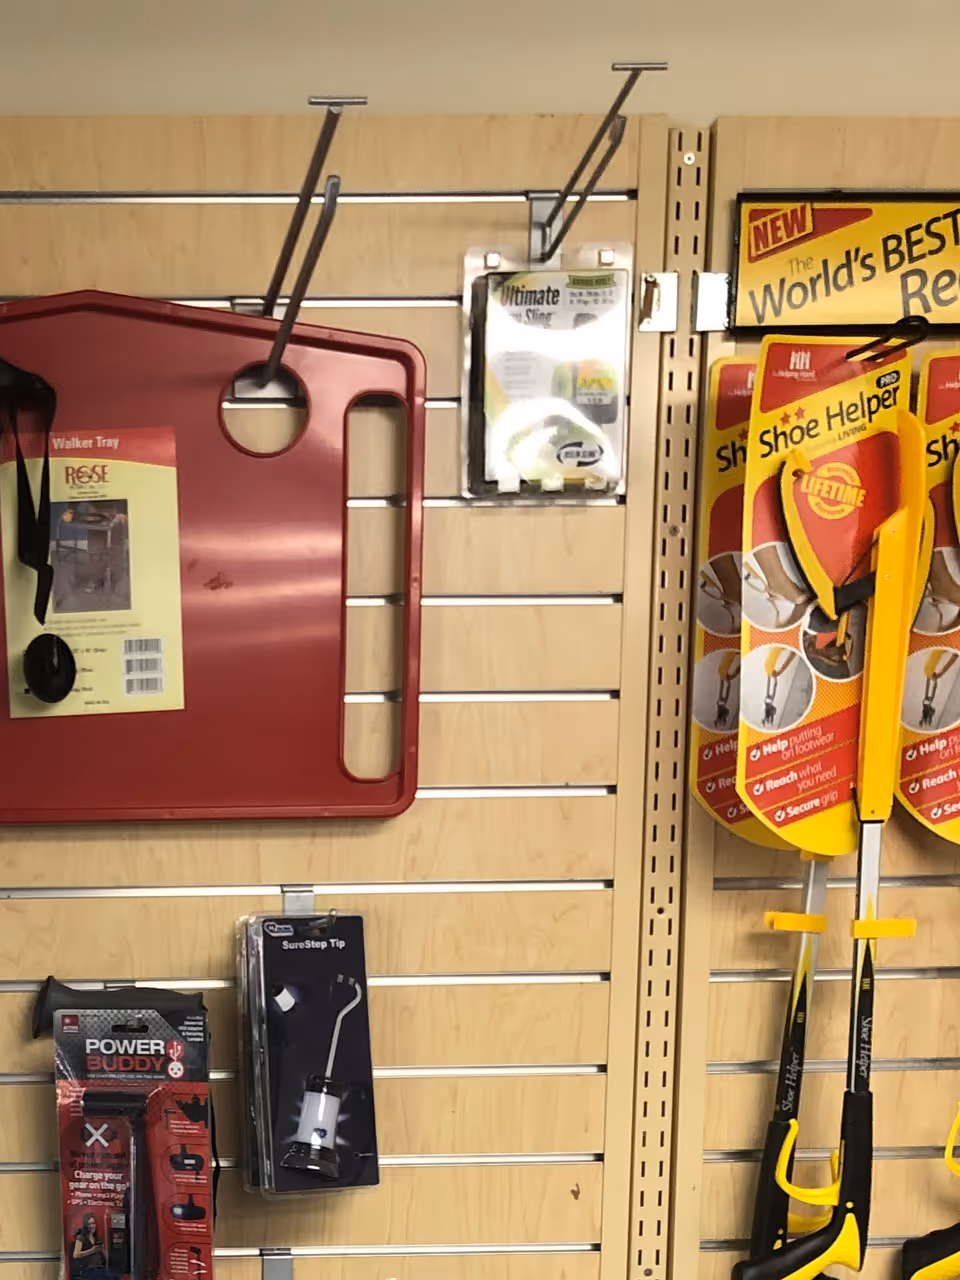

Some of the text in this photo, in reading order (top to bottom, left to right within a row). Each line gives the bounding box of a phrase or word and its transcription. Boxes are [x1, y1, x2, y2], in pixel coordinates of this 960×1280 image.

[751, 205, 807, 253] NEW
[789, 256, 814, 276] The
[501, 285, 560, 306] Ultimate
[748, 247, 876, 324] World's
[759, 386, 900, 458] Shoe Helper
[53, 436, 119, 450] Walker Tray
[65, 465, 109, 485] ROSE
[801, 472, 865, 507] LIFETIME
[763, 726, 822, 756] Help putting
[795, 732, 835, 756] footwear
[919, 738, 947, 756] Help
[765, 761, 822, 791] Reach what
[797, 766, 837, 794] you need
[922, 769, 956, 789] Reach
[786, 790, 838, 817] Secure grip
[282, 939, 346, 950] SureStep Tip
[85, 1039, 165, 1055] POWER
[86, 1056, 166, 1071] BUDDY
[69, 1182, 87, 1191] gear
[74, 1171, 123, 1182] Charge your
